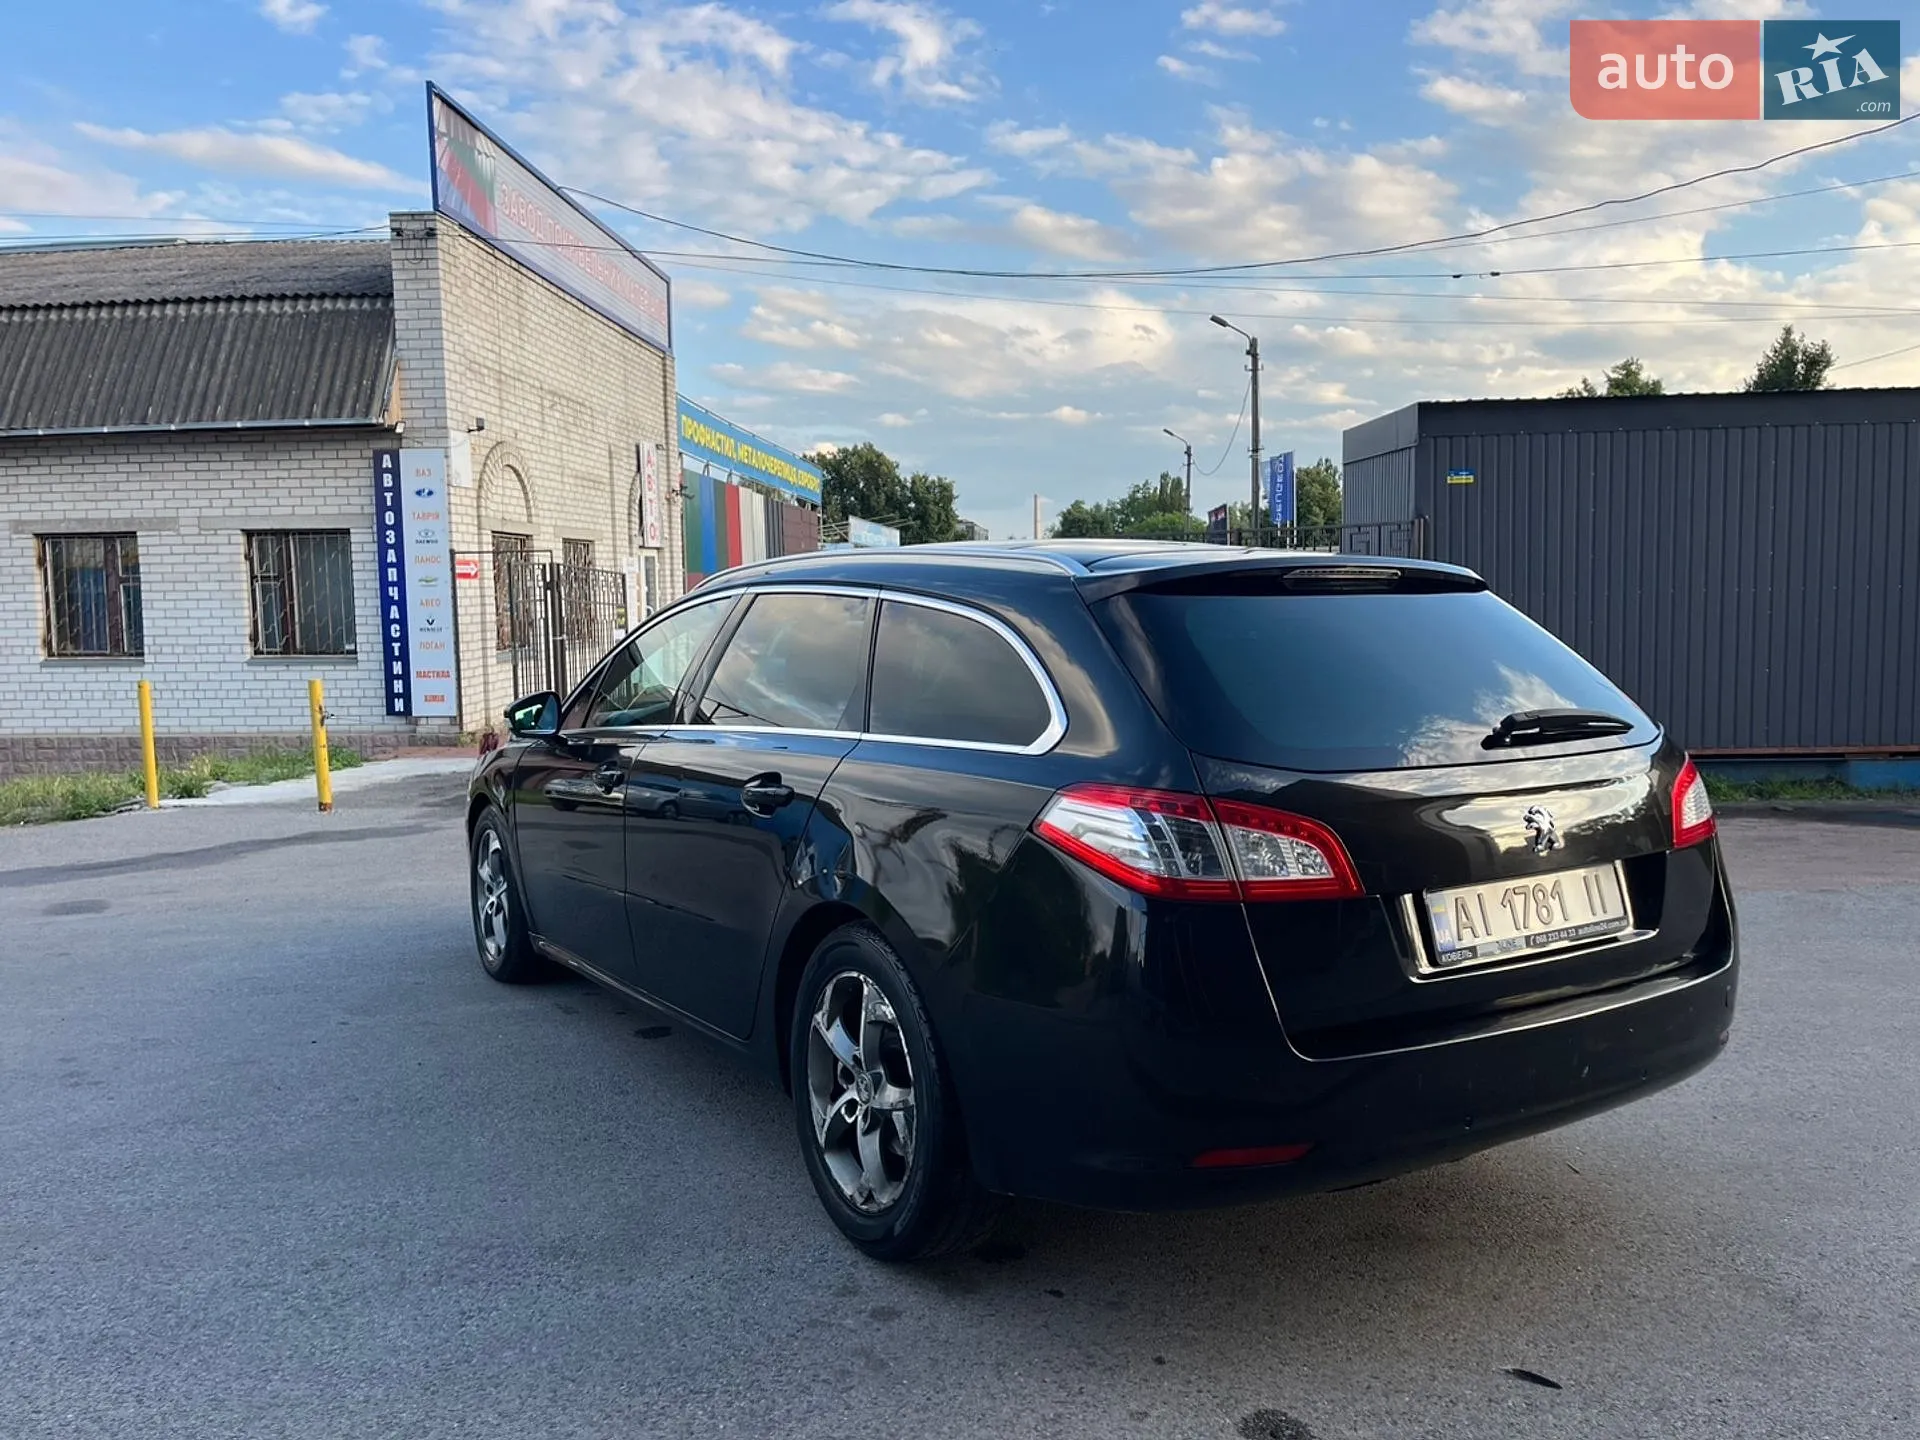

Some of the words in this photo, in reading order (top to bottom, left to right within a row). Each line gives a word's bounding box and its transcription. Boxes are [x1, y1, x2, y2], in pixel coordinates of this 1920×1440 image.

[500, 182, 544, 242] ЗАВОД
[382, 453, 405, 713] АВТОЗАПЧАСТИНИ
[1455, 892, 1493, 941] AI
[1501, 879, 1569, 931] 1781
[1583, 874, 1608, 917] II
